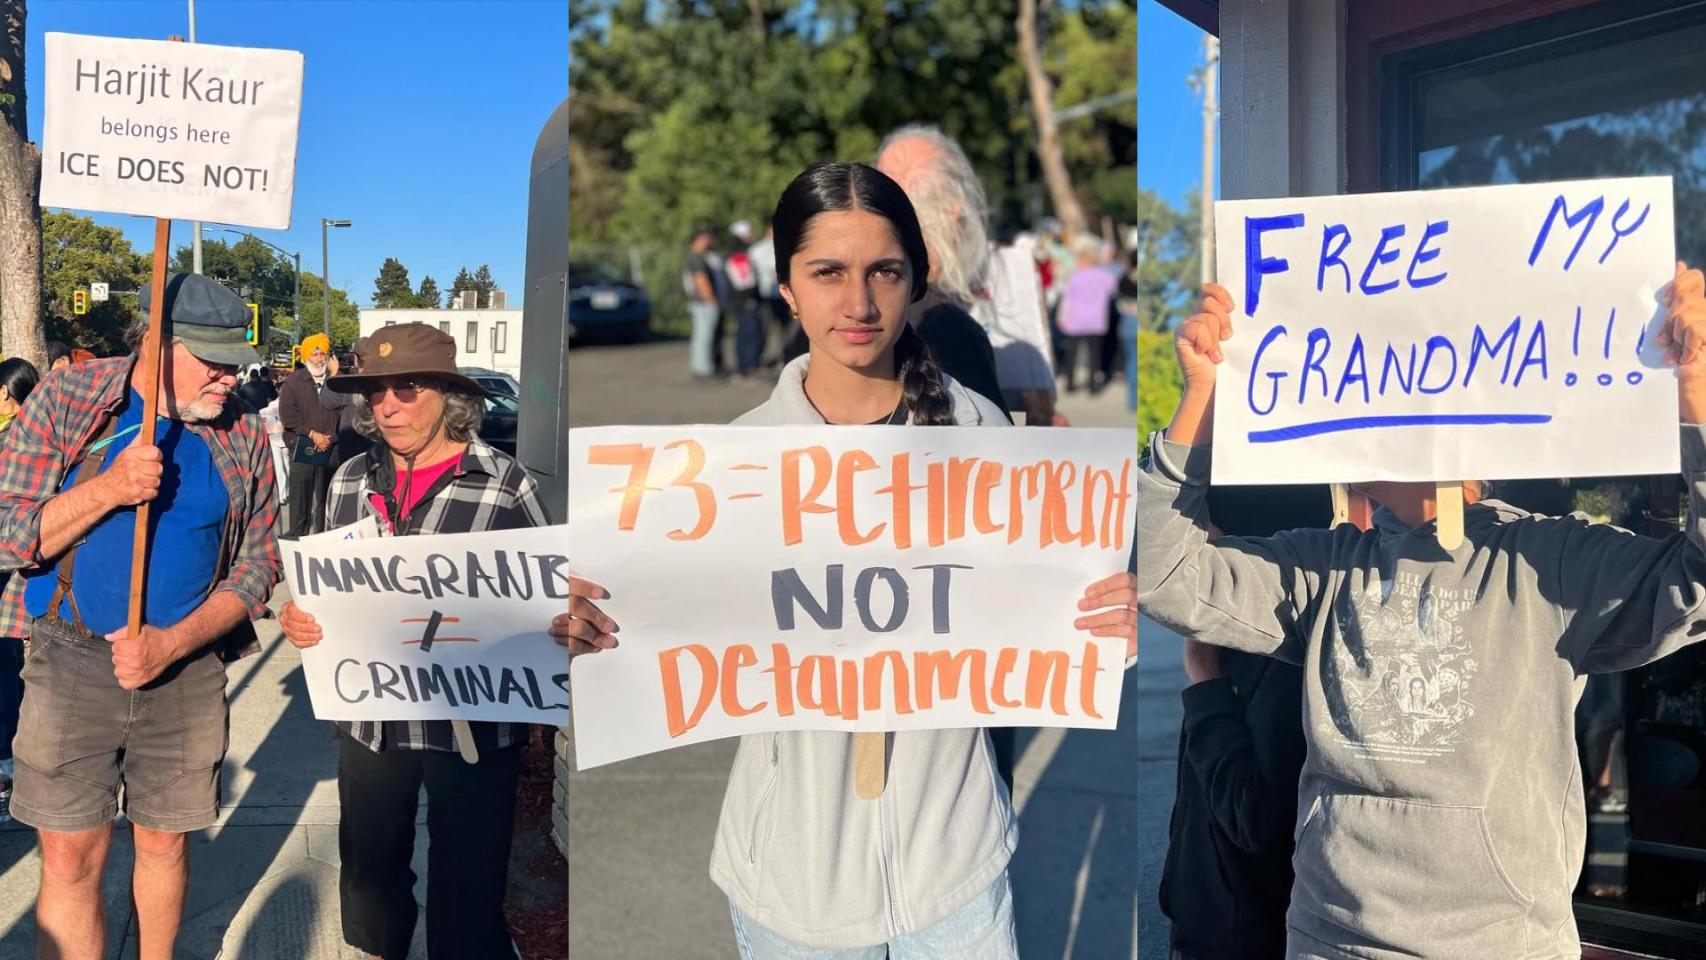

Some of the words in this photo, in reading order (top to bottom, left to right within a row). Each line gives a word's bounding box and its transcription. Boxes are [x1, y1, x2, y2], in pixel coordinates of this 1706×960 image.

[75, 58, 171, 105] Harjit
[182, 67, 264, 105] Kaur
[101, 116, 178, 143] belongs
[187, 123, 231, 145] here
[59, 151, 99, 177] ICE
[117, 157, 185, 184] DOES
[203, 164, 269, 192] NOT!
[1244, 213, 1449, 317] FREE
[1528, 195, 1650, 271] MY
[1248, 306, 1645, 416] GRANDMA!!!
[587, 438, 717, 541] 73
[771, 563, 973, 634] NOT
